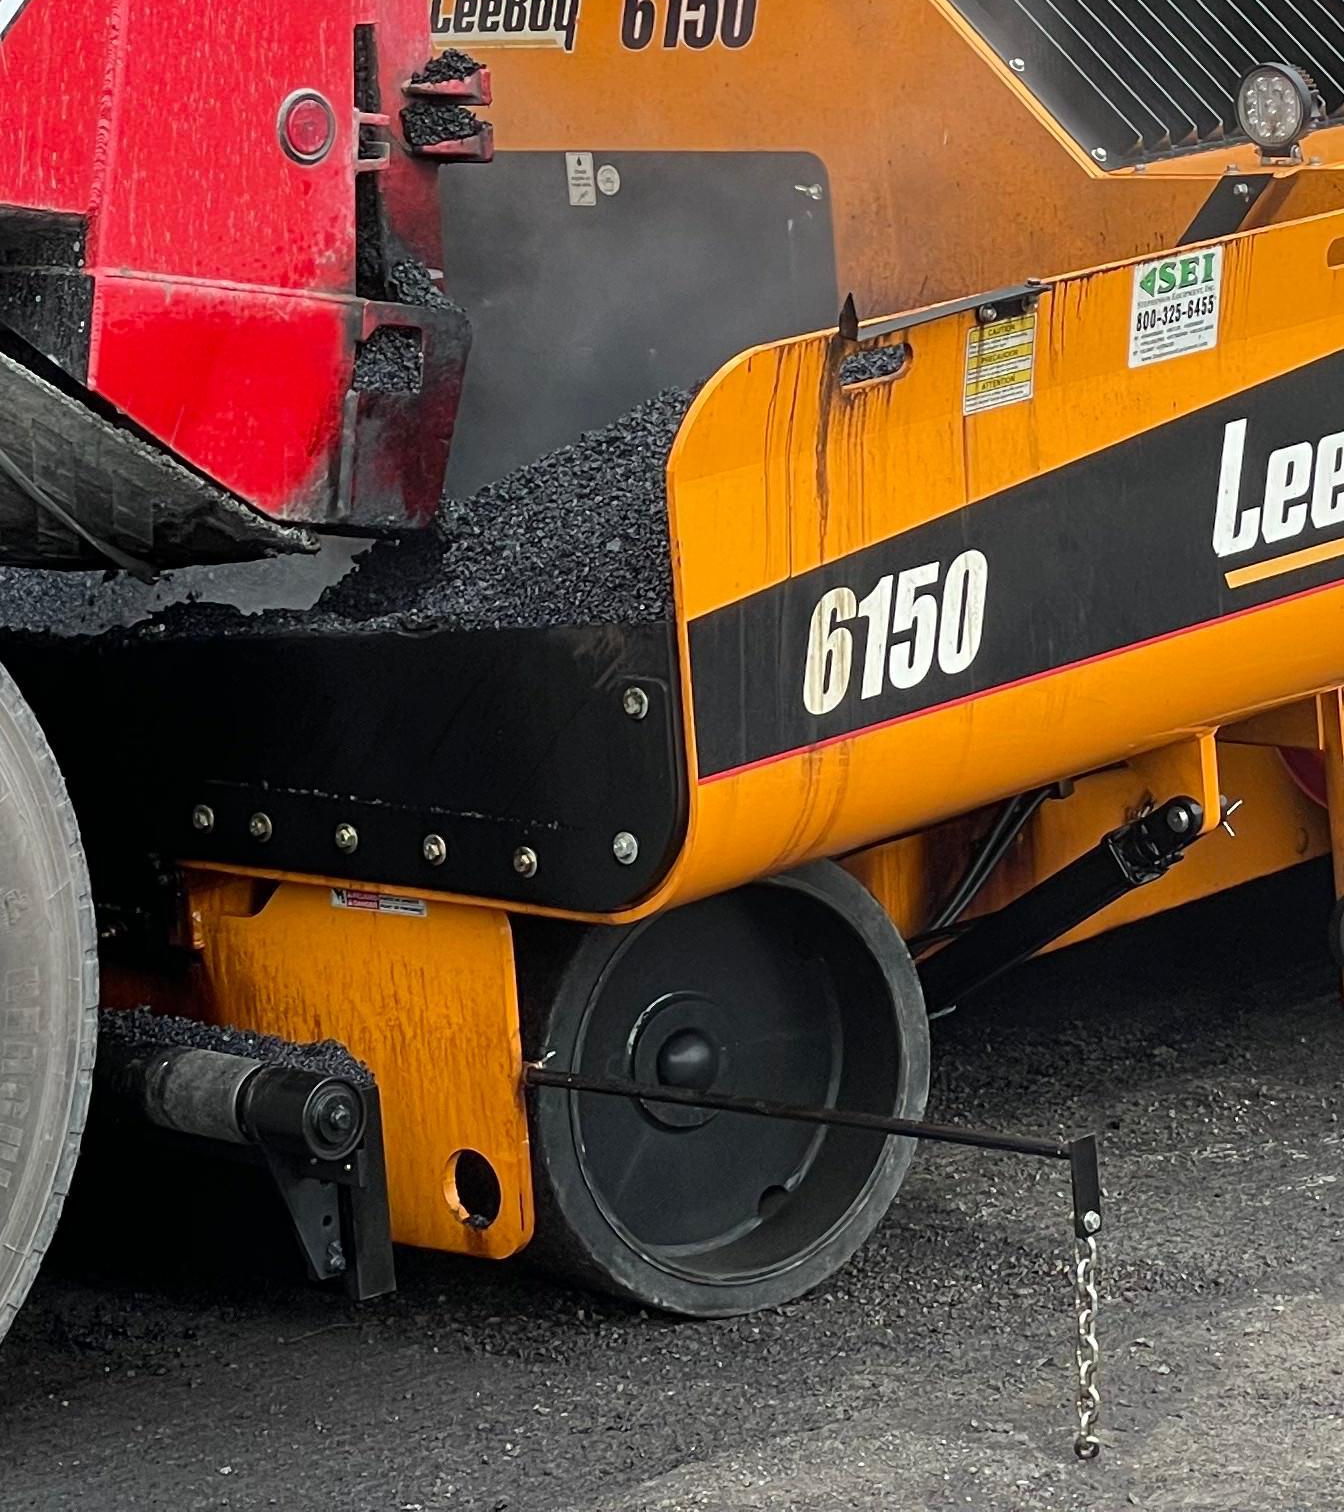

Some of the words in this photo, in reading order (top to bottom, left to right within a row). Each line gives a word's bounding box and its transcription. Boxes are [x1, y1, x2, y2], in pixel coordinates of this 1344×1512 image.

[1157, 252, 1216, 294] SEI
[1136, 294, 1215, 332] 800-325-6455
[803, 549, 988, 716] 6150
